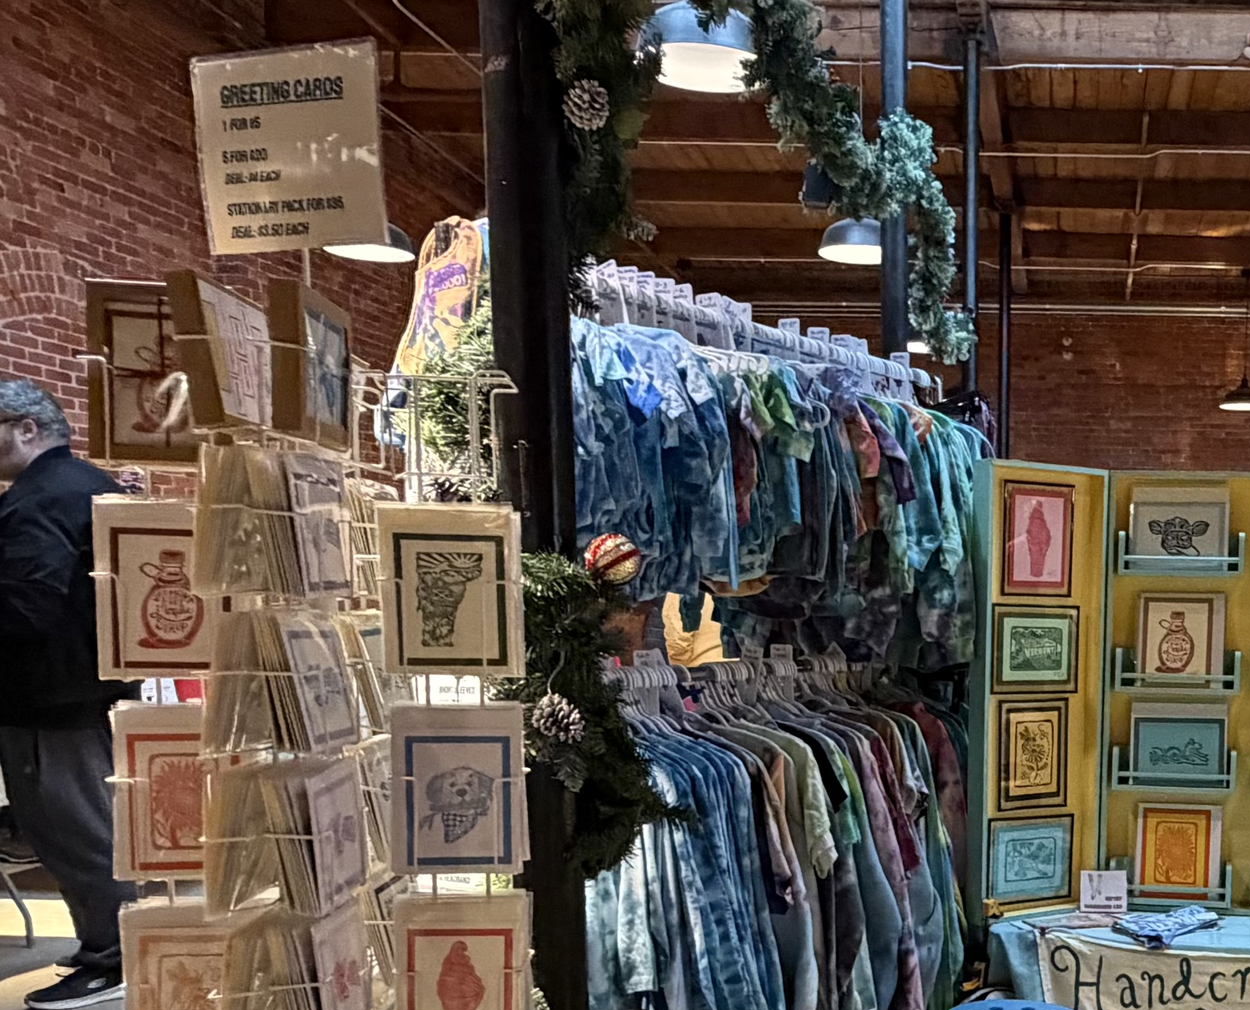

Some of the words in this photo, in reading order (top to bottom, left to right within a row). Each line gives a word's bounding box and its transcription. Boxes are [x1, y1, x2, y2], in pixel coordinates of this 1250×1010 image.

[220, 81, 291, 105] GREETING
[294, 76, 344, 99] CARDS
[230, 118, 248, 131] FOR
[230, 149, 248, 163] FOR
[282, 199, 305, 214] PACK
[307, 198, 325, 212] FOR
